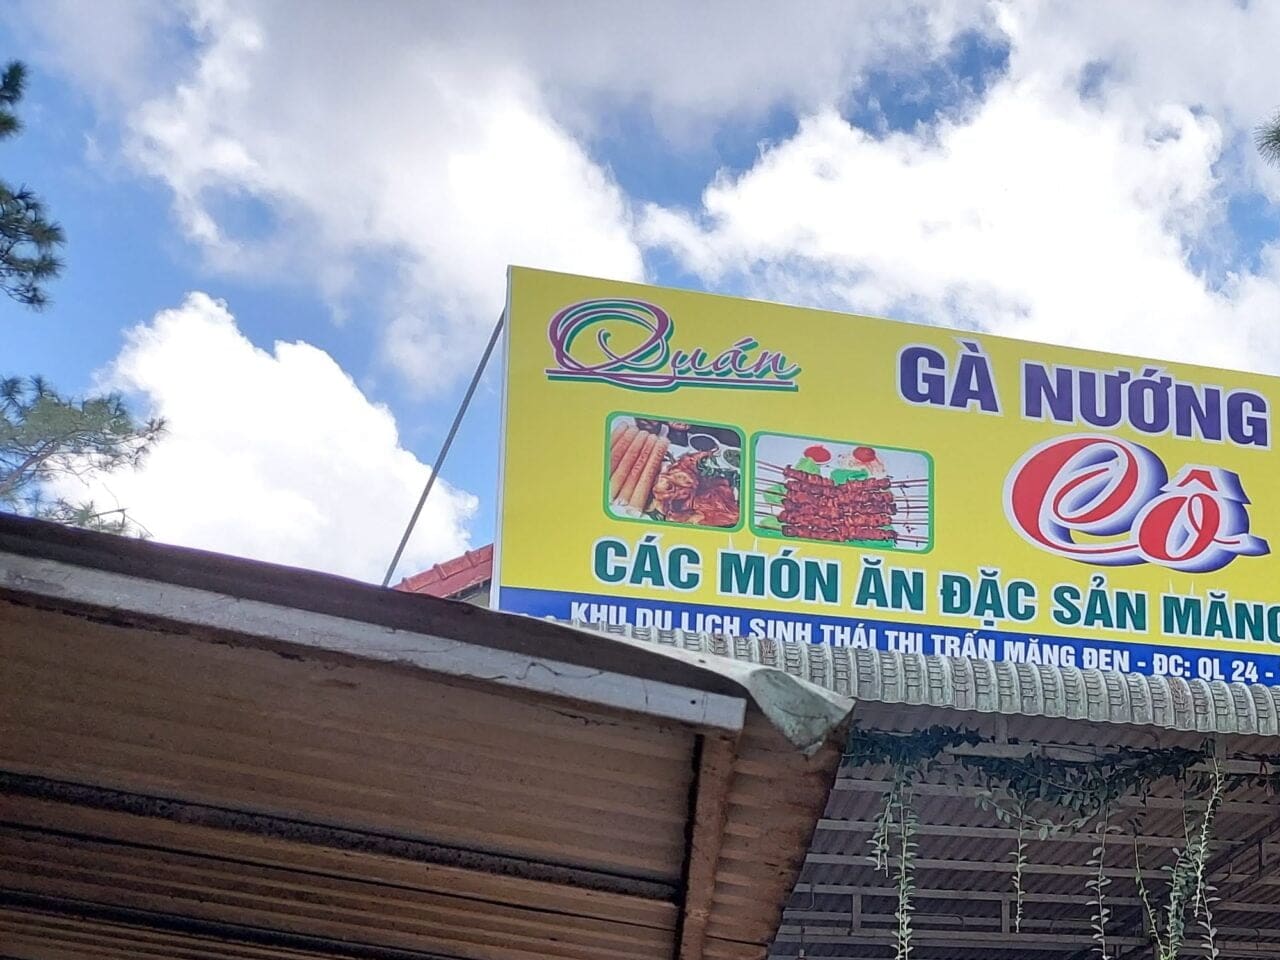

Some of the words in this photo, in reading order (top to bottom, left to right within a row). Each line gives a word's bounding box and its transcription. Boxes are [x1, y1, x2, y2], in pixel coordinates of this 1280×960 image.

[546, 298, 800, 391] Quán
[899, 341, 999, 413] GÀ
[1024, 362, 1268, 447] NƯỚNG
[1004, 433, 1271, 573] Cô
[594, 537, 700, 589] CÁC
[721, 550, 838, 604] MÓN
[857, 557, 919, 609] ĂN
[941, 569, 1035, 630] ĐẶC
[1053, 575, 1147, 631] SẢN
[571, 602, 626, 626] KHU
[636, 608, 671, 631] DU
[750, 618, 812, 643] SINH
[820, 622, 876, 648] THÁI
[931, 629, 995, 660] TRẤN
[1003, 639, 1075, 667] MĂNG
[1083, 647, 1129, 672] ĐEN
[1153, 653, 1190, 677] ĐC:
[1198, 659, 1225, 681] QL
[1231, 661, 1258, 682] 24
